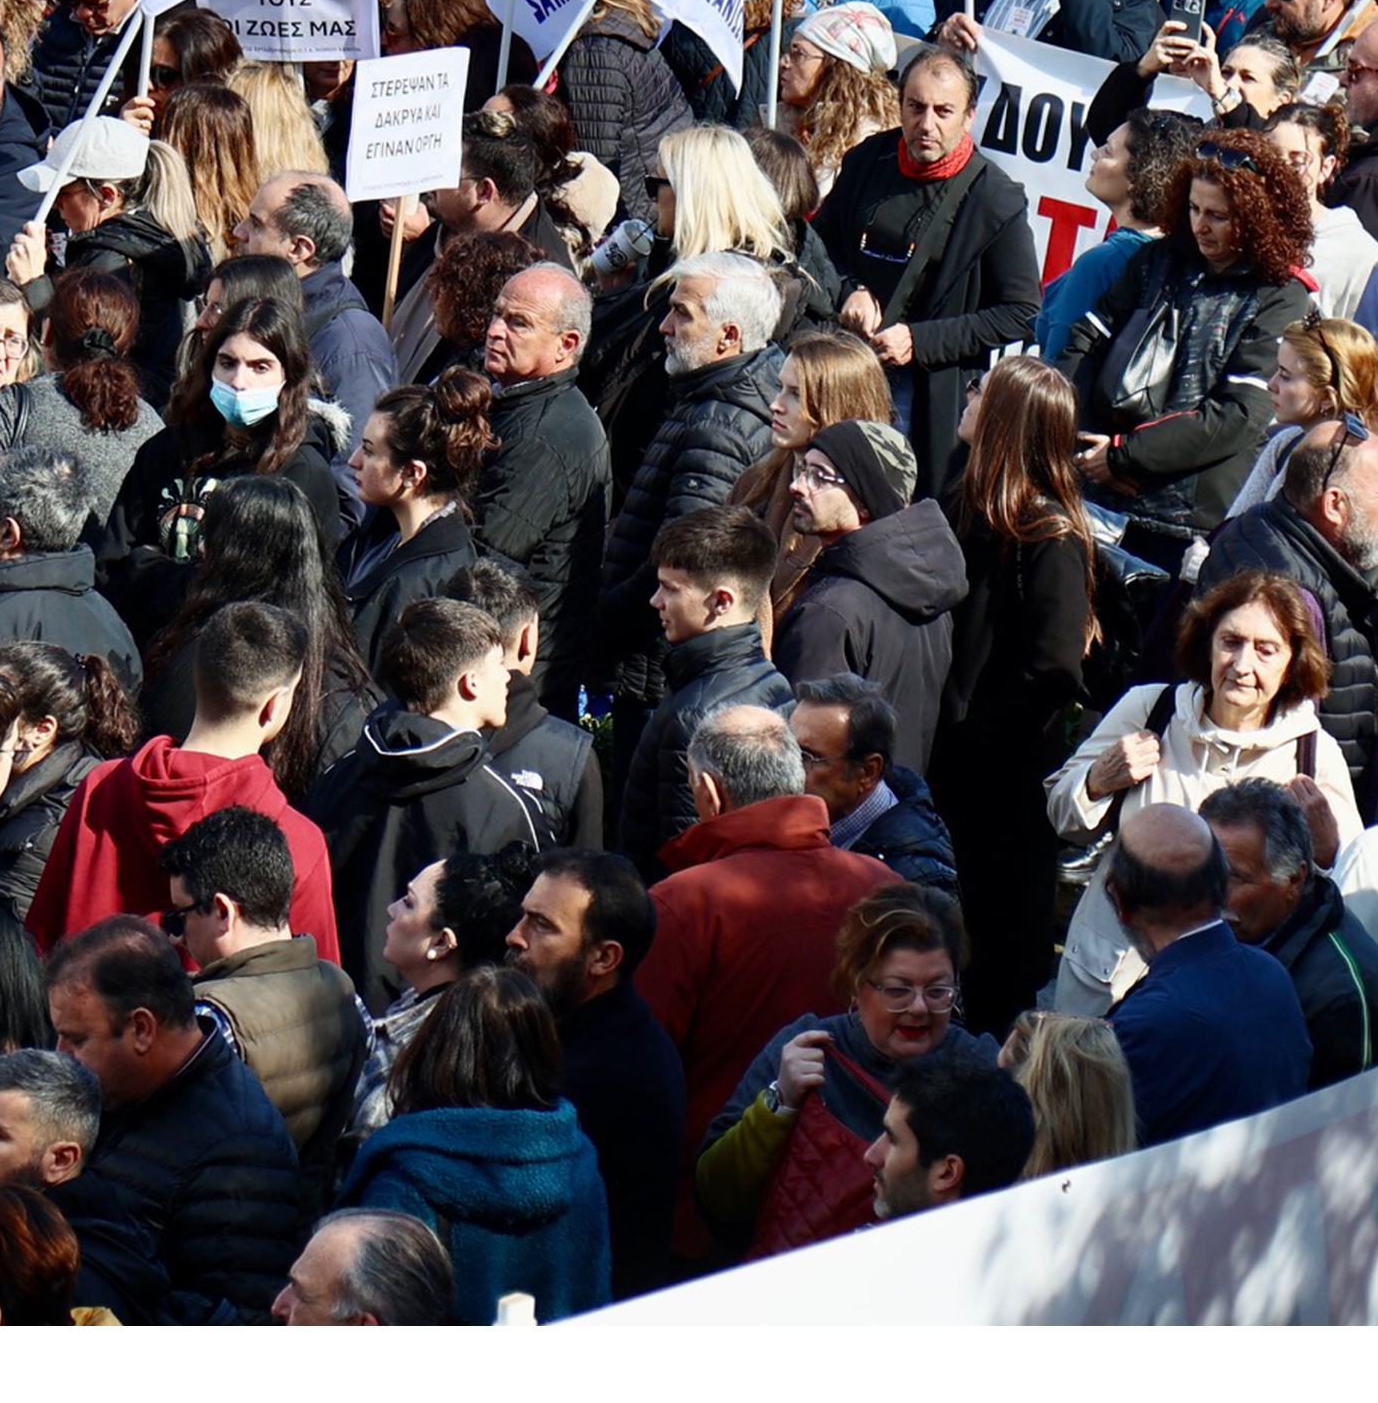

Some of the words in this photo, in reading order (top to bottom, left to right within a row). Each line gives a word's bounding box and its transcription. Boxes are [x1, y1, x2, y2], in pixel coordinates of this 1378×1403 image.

[246, 20, 304, 37] ΖΩΕΣ
[310, 20, 357, 37] ΜΑΣ
[371, 73, 435, 98] ΣΤΕΡΕΨΑΝ
[437, 72, 450, 89] ΤΑ
[375, 107, 423, 129] ΔΑΚΡΥΑ
[424, 103, 442, 123] ΚΑΙ
[366, 139, 414, 160] ΕΓΙΝΑΝ
[415, 132, 443, 154] ΟΡΓΗ
